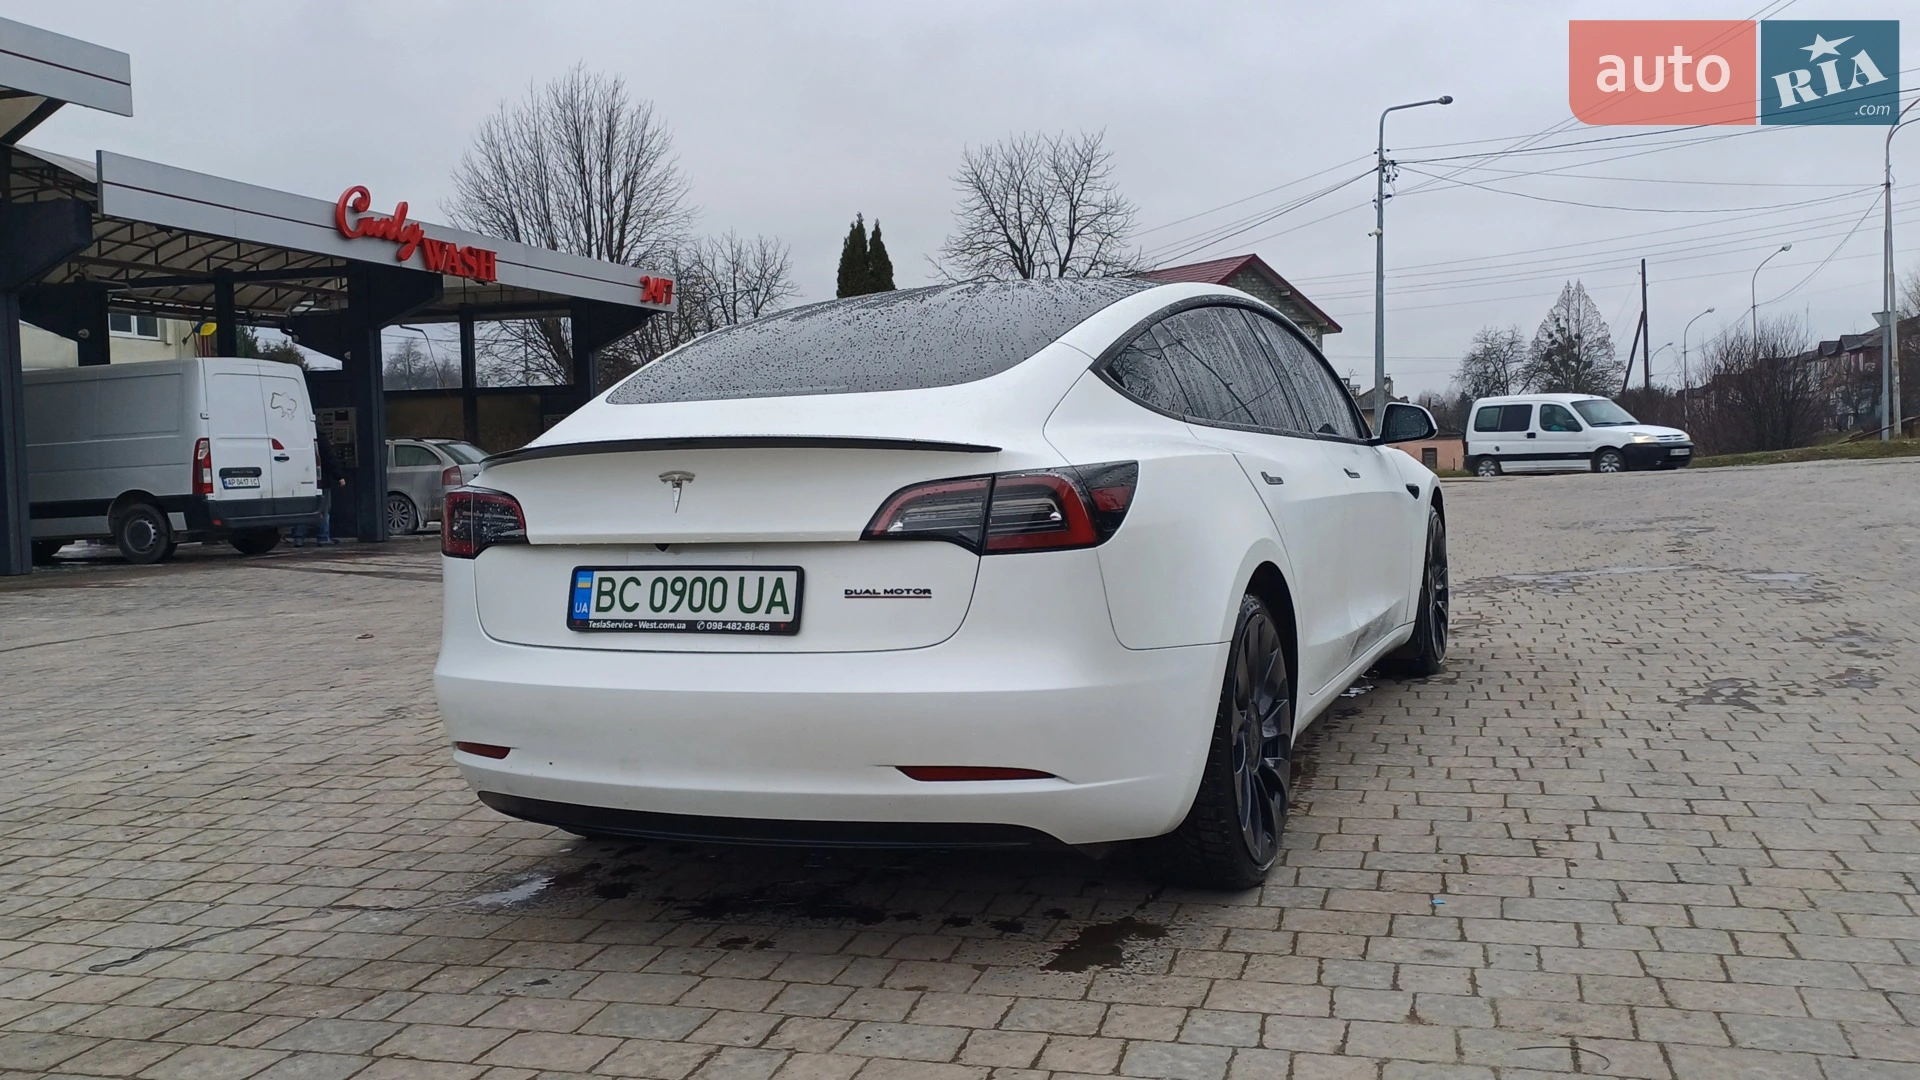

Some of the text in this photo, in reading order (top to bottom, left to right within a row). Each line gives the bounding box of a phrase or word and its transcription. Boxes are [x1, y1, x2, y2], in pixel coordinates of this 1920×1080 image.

[421, 238, 497, 282] WASH
[595, 576, 790, 614] BC 0900 UA
[574, 602, 588, 613] UA
[588, 620, 633, 630] TeslaService
[639, 621, 686, 630] West.com.ua
[706, 622, 770, 631] 098-482-88-68
